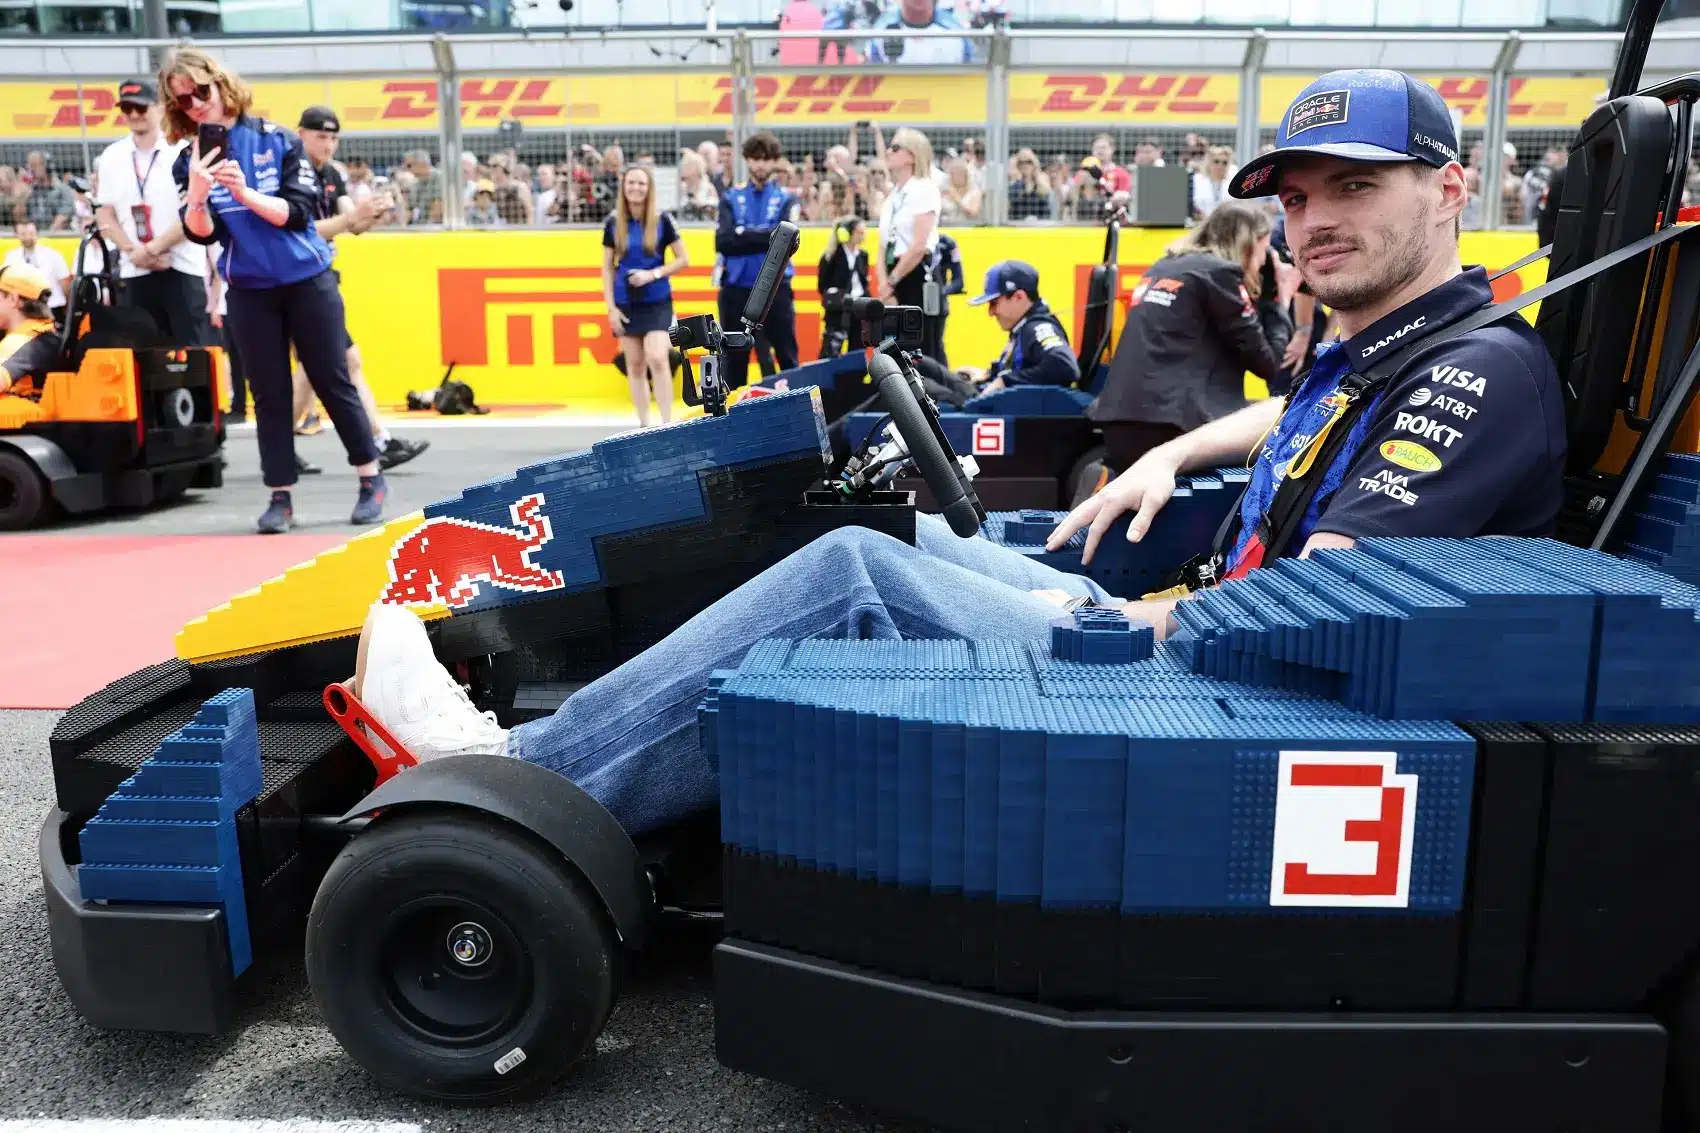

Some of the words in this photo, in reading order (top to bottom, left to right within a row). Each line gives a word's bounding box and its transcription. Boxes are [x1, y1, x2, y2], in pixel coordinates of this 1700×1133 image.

[381, 80, 562, 119] DHL
[711, 75, 896, 114] DHL
[1040, 76, 1218, 112] DHL
[1294, 94, 1341, 115] ORACLE
[1437, 77, 1533, 116] HL
[1291, 113, 1339, 131] RACING
[1362, 315, 1427, 358] DAMAC
[1431, 365, 1487, 398] VISA
[1431, 394, 1478, 421] AT&T
[974, 420, 1002, 453] 6
[1393, 411, 1464, 448] ROKT
[1394, 446, 1434, 469] RAUCH
[1358, 477, 1419, 506] TRADE
[1373, 469, 1409, 488] AVA
[1277, 758, 1411, 900] 3
